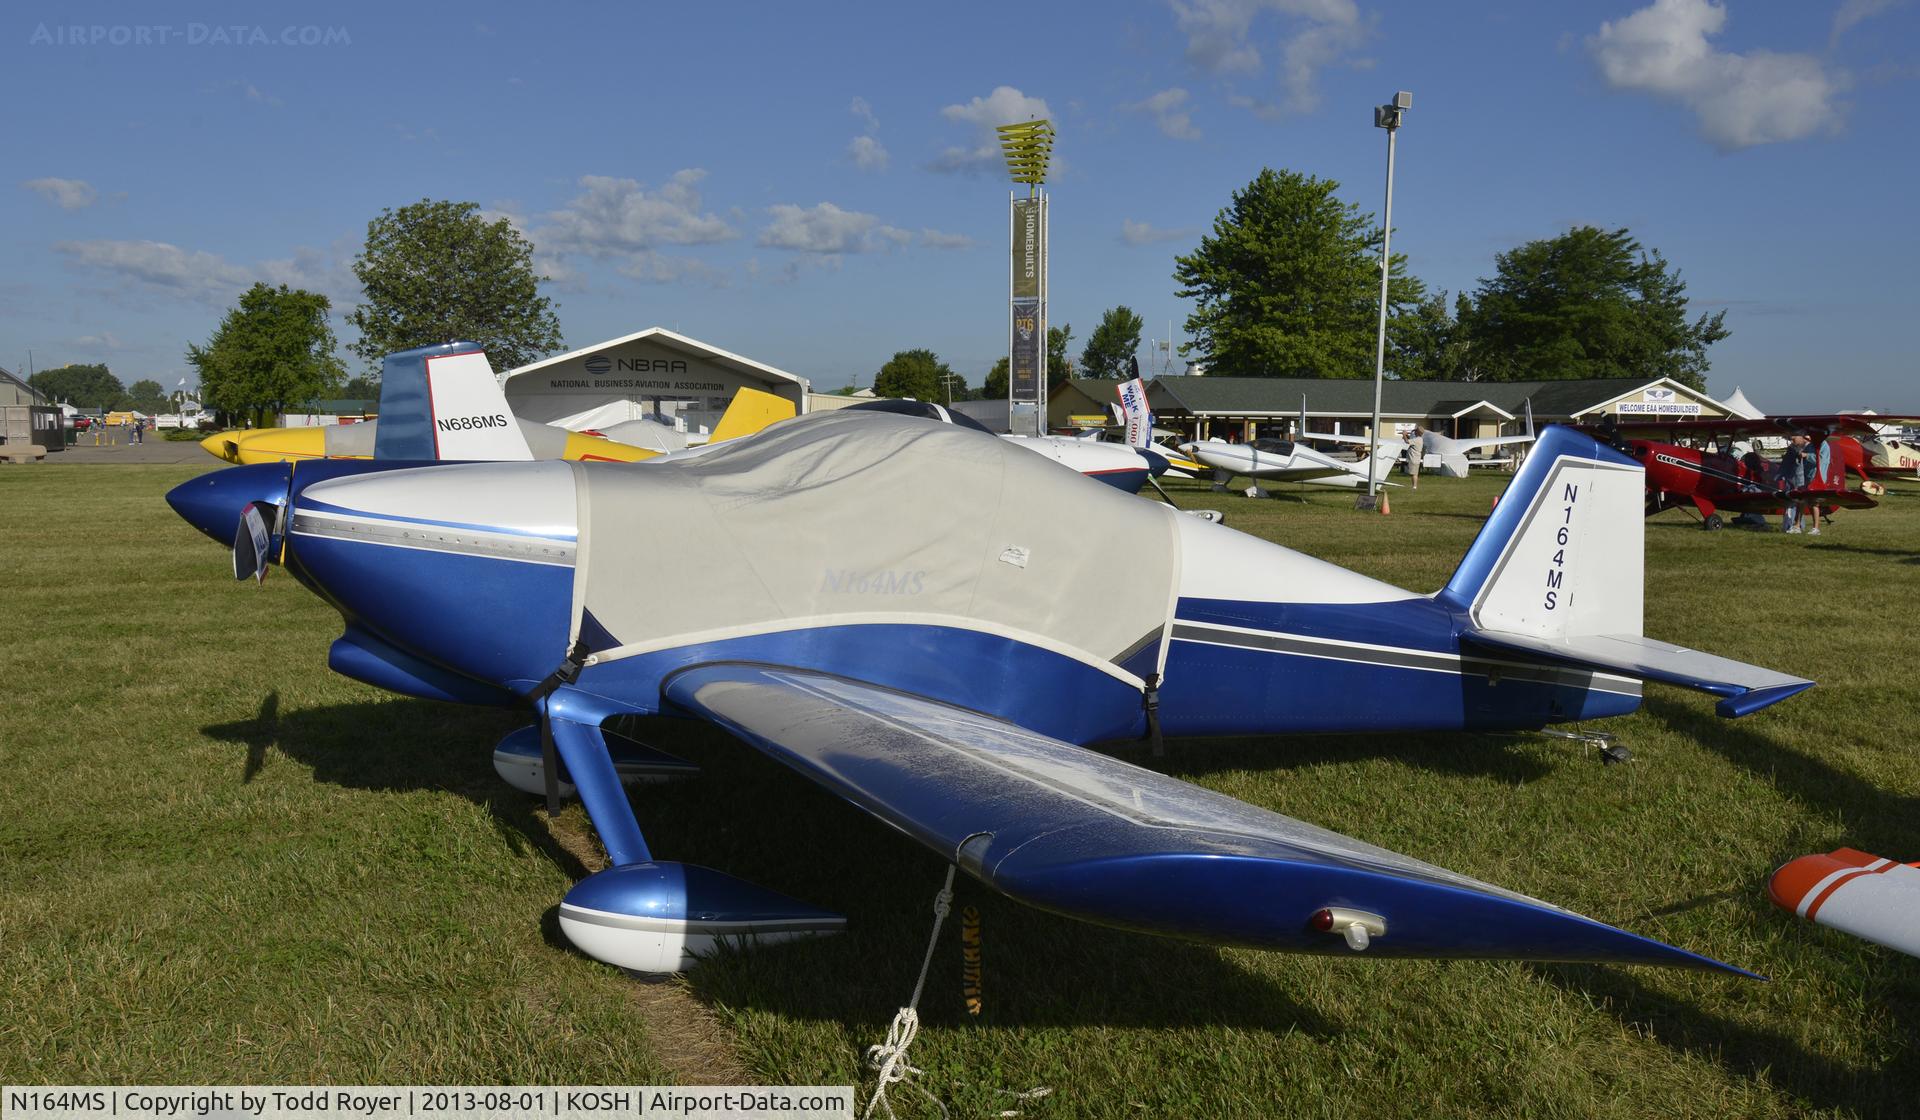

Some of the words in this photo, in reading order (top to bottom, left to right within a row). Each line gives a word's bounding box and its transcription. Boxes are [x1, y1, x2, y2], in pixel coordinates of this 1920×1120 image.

[1025, 215, 1035, 278] HOMEBUILTS
[617, 359, 687, 373] NBAA
[551, 380, 590, 388] NATIONAL
[594, 379, 633, 388] BUSINESS
[635, 380, 670, 389] AVIATION
[674, 381, 725, 391] ASSOCIATION
[1122, 394, 1131, 409] ME
[1127, 385, 1139, 413] WALK
[1619, 404, 1646, 412] WELCOME
[1646, 404, 1658, 413] EAA
[1658, 404, 1699, 414] HOMEBUILDERS
[437, 414, 508, 432] N686MS
[819, 568, 927, 596] N164MS
